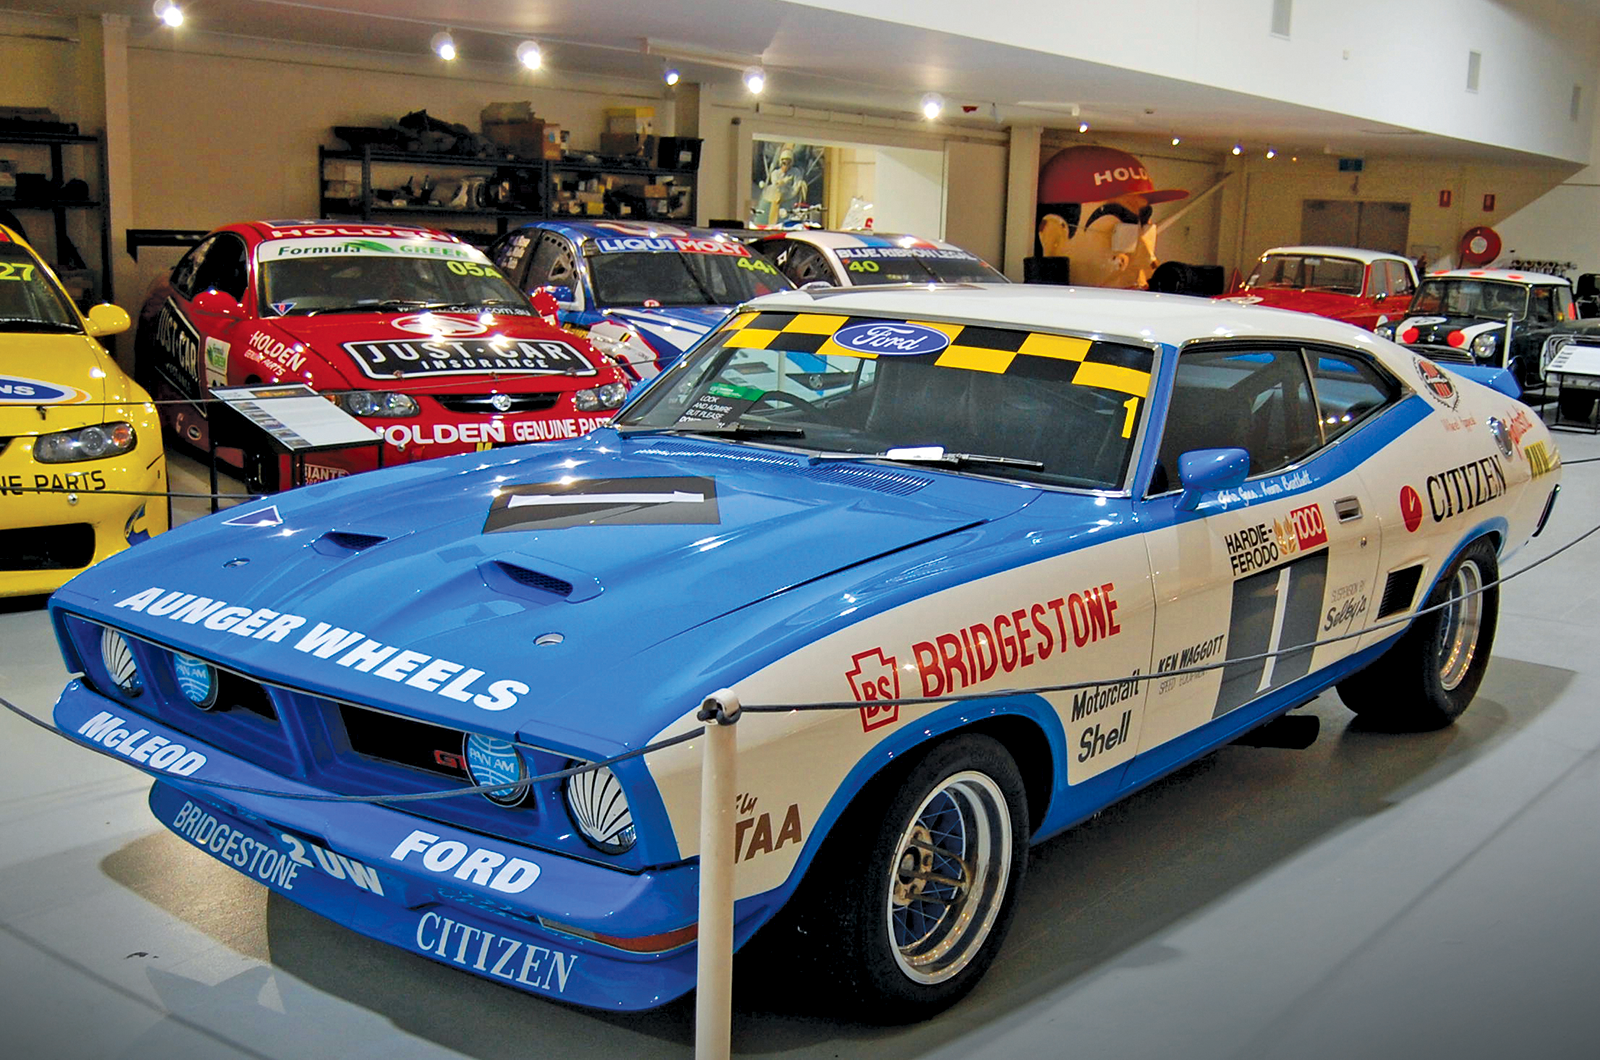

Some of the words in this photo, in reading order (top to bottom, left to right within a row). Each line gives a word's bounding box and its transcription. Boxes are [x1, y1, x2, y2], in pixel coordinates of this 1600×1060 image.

[278, 239, 361, 256] Formula
[601, 238, 674, 251] LIQUI
[678, 240, 743, 255] MOLY
[836, 248, 881, 259] BLUE
[849, 260, 879, 273] 40
[249, 330, 307, 372] HOLDEN
[365, 342, 471, 363] JUST
[497, 341, 567, 361] CAR
[852, 325, 920, 351] Ford
[421, 357, 550, 370] INSURANCE
[513, 418, 579, 442] GENUINE
[1121, 396, 1139, 439] 1
[35, 470, 106, 494] PARTS
[1426, 454, 1507, 523] CITIZEN
[1225, 523, 1273, 555] HARDIE-
[1293, 506, 1323, 541] 1000
[1229, 541, 1279, 576] FERODO
[113, 587, 307, 643] AUNGER
[293, 621, 531, 711] WHEELS
[911, 582, 1121, 698] BRIDGESTONE
[1256, 566, 1291, 694] 1
[176, 663, 192, 677] PAN
[193, 668, 207, 679] AM
[1158, 652, 1179, 673] KEN
[1179, 634, 1225, 669] WAGGOTT
[861, 676, 891, 718] BS
[1071, 669, 1140, 722] Motorcraft
[78, 711, 207, 777] McLEOD
[1077, 710, 1132, 763] Shell
[469, 747, 492, 767] PAN
[493, 759, 515, 773] AM
[173, 800, 302, 892] BRIDGESTONE
[391, 829, 541, 894] FORD
[311, 843, 385, 897] UW
[416, 911, 578, 993] CITIZEN
